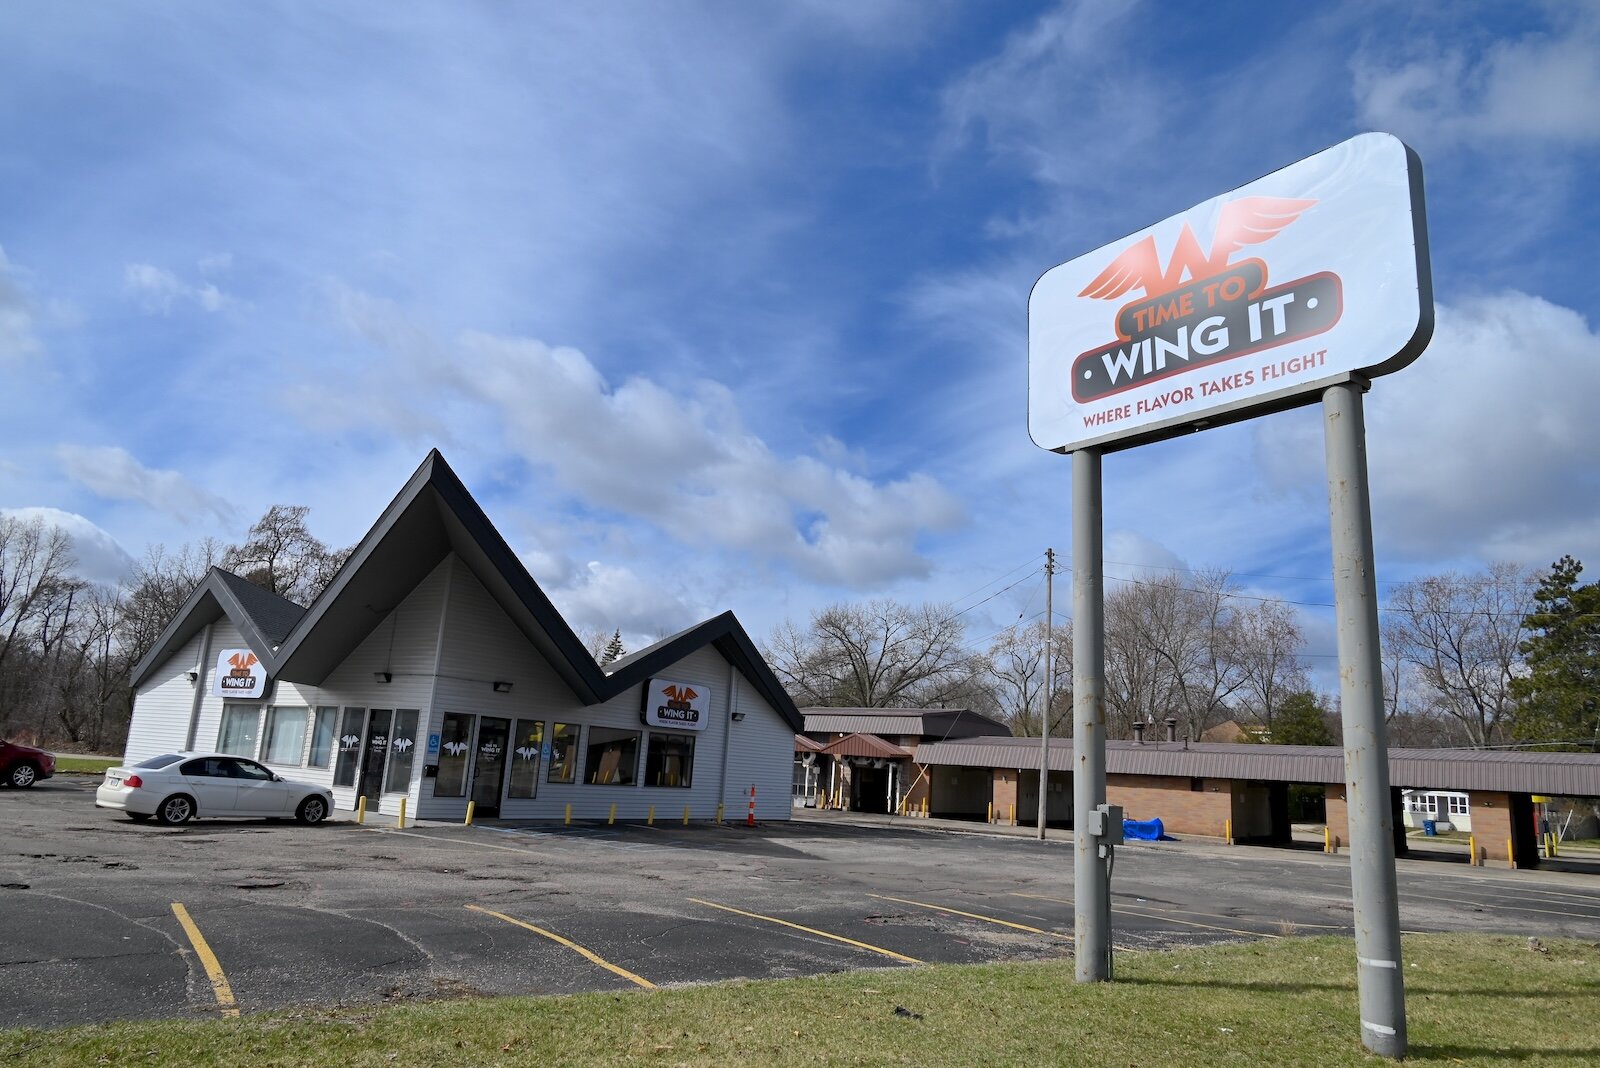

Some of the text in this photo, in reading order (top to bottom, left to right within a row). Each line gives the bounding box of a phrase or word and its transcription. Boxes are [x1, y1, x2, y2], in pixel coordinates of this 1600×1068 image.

[1133, 276, 1246, 333] TIME TO
[1101, 292, 1295, 385] WING IT
[1083, 349, 1328, 428] WHERE FLAVOR TAKES FLIGHT
[225, 678, 252, 687] WING IT
[663, 708, 694, 720] WING IT
